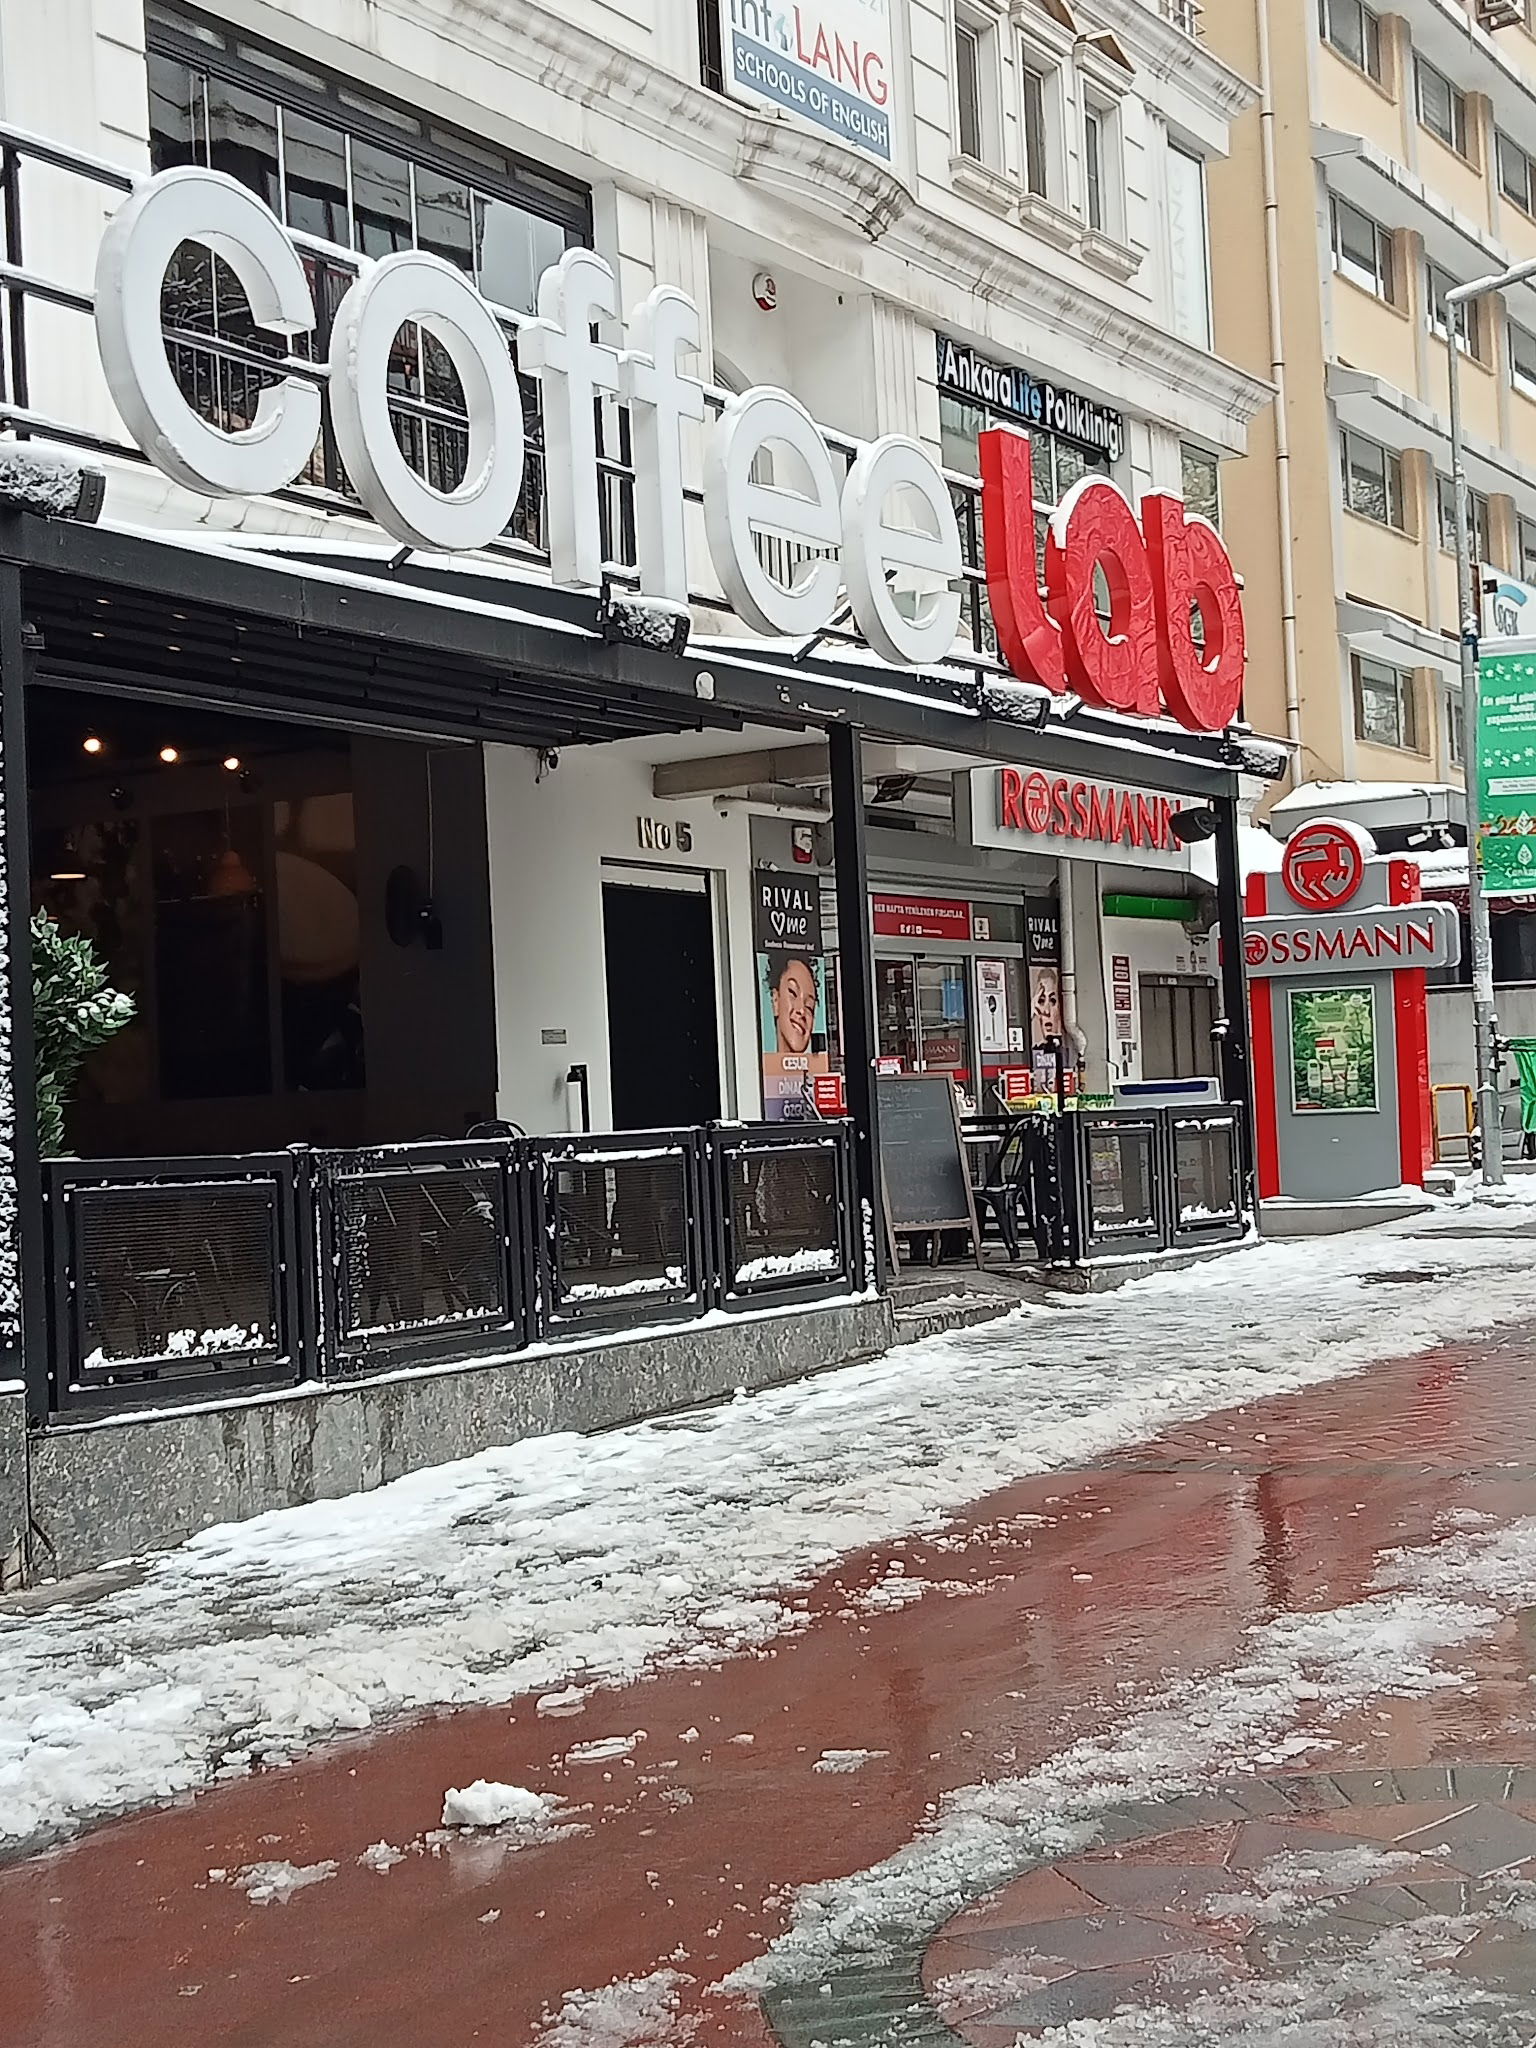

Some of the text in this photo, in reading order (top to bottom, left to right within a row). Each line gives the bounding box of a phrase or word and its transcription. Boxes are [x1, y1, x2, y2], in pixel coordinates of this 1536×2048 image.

[736, 46, 888, 148] SCHOOLS OF ENGLISH
[1045, 384, 1124, 463] Polikliniği
[96, 165, 1246, 733] coffee lab
[1000, 768, 1182, 852] ROSSMANN
[637, 816, 692, 852] No 5
[762, 886, 813, 911] RIVAL
[786, 916, 807, 935] me
[1028, 917, 1057, 933] RIVAL
[1243, 921, 1433, 966] OSSMANN
[783, 1056, 808, 1071] CESUR
